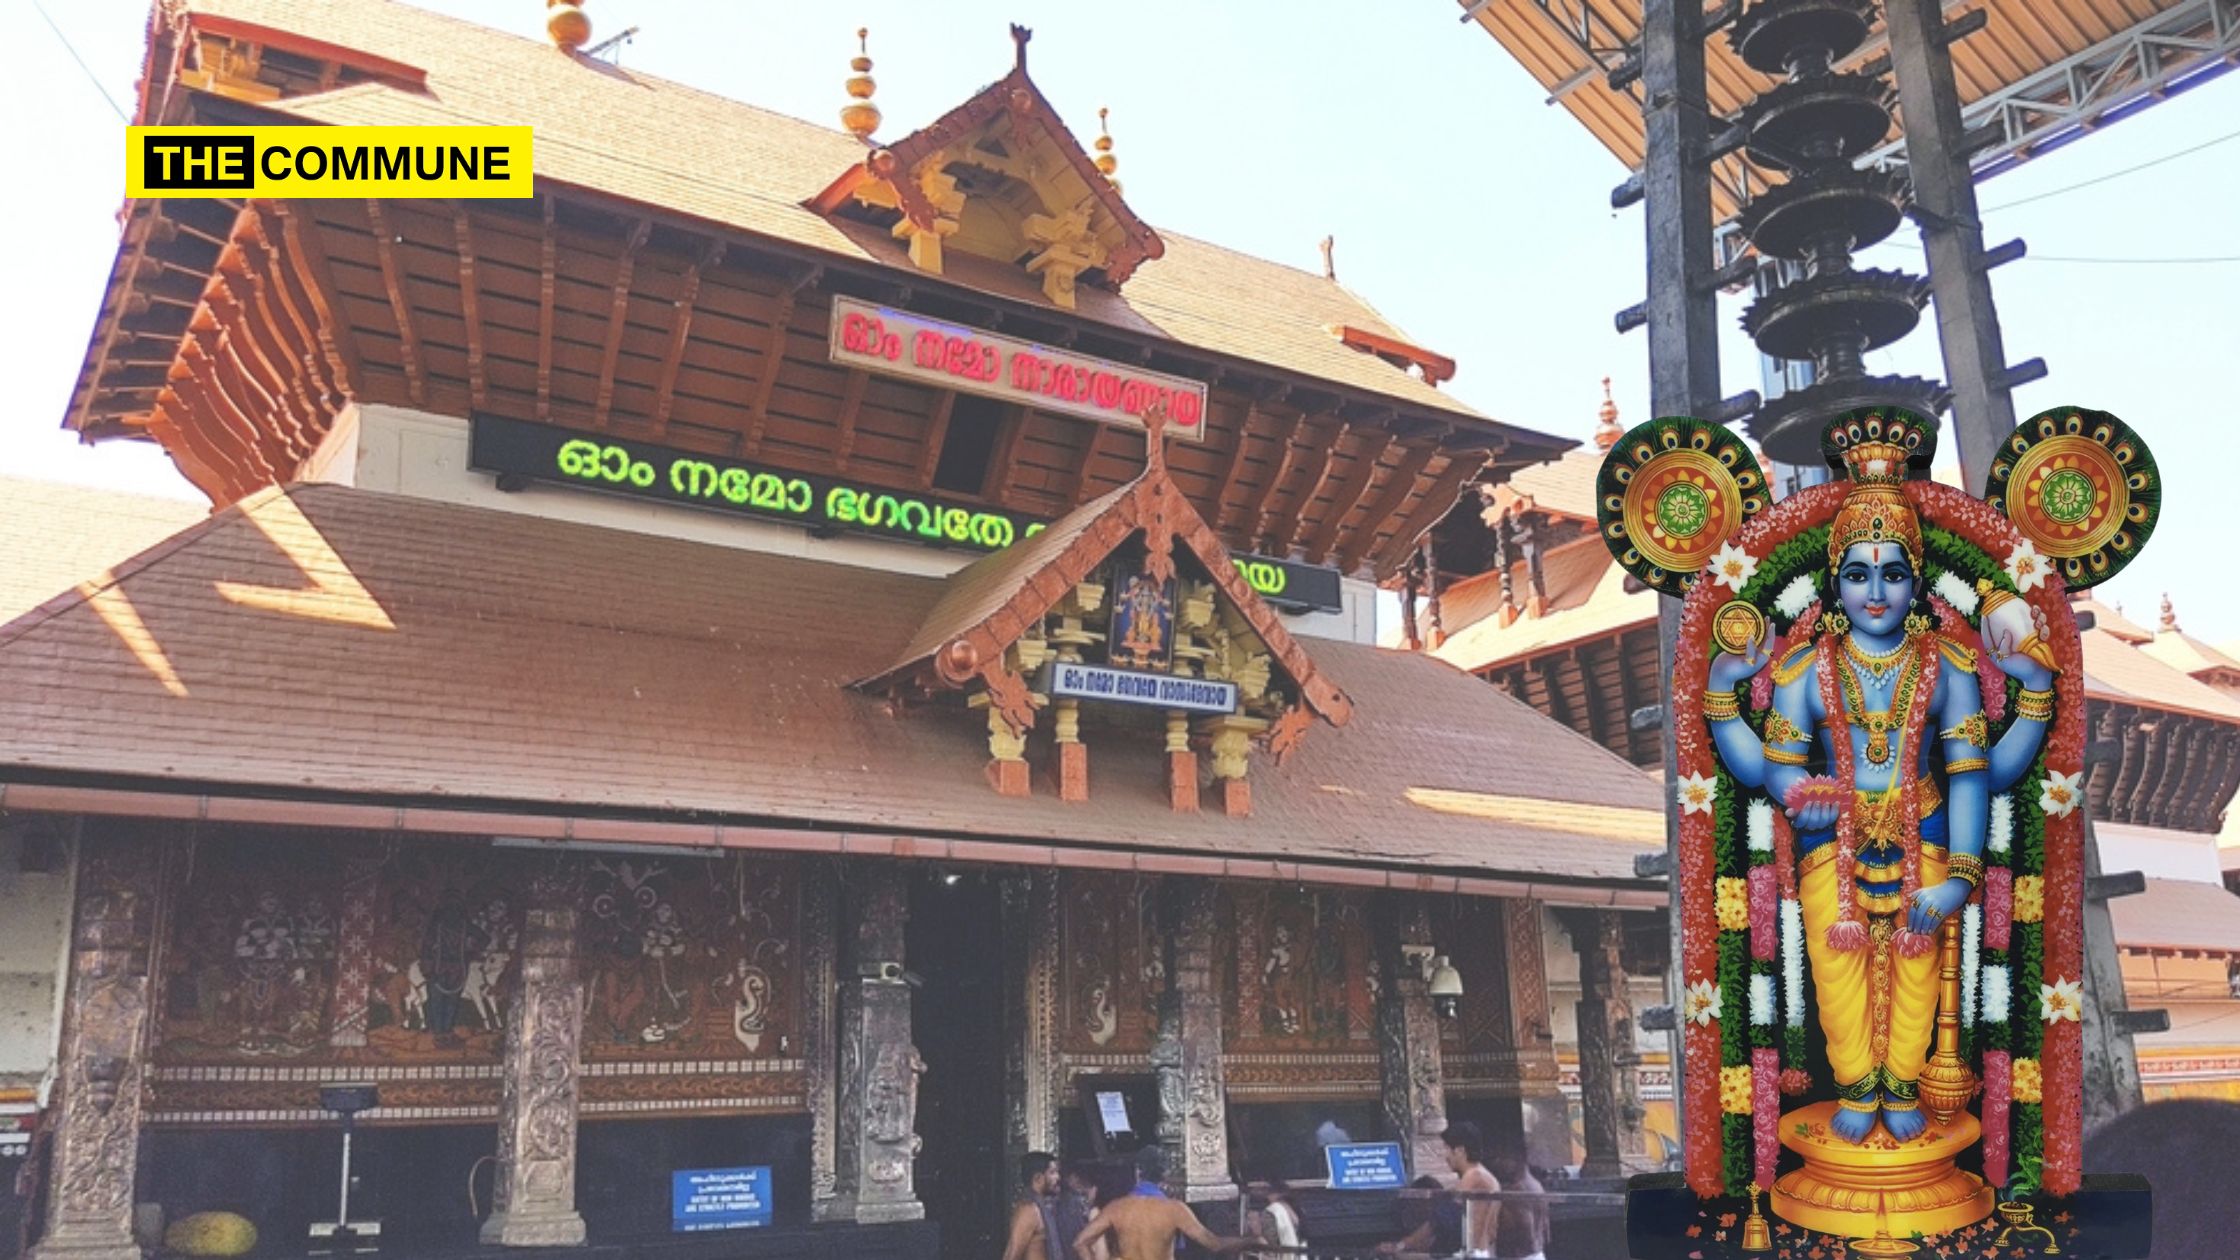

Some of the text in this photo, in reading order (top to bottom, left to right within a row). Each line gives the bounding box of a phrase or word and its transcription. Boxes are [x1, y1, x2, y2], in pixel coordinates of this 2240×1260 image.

[842, 312, 903, 361] ഓം
[912, 328, 1001, 384] നമോ
[557, 438, 1014, 548] ഓം നമോ ഭഗവതേ
